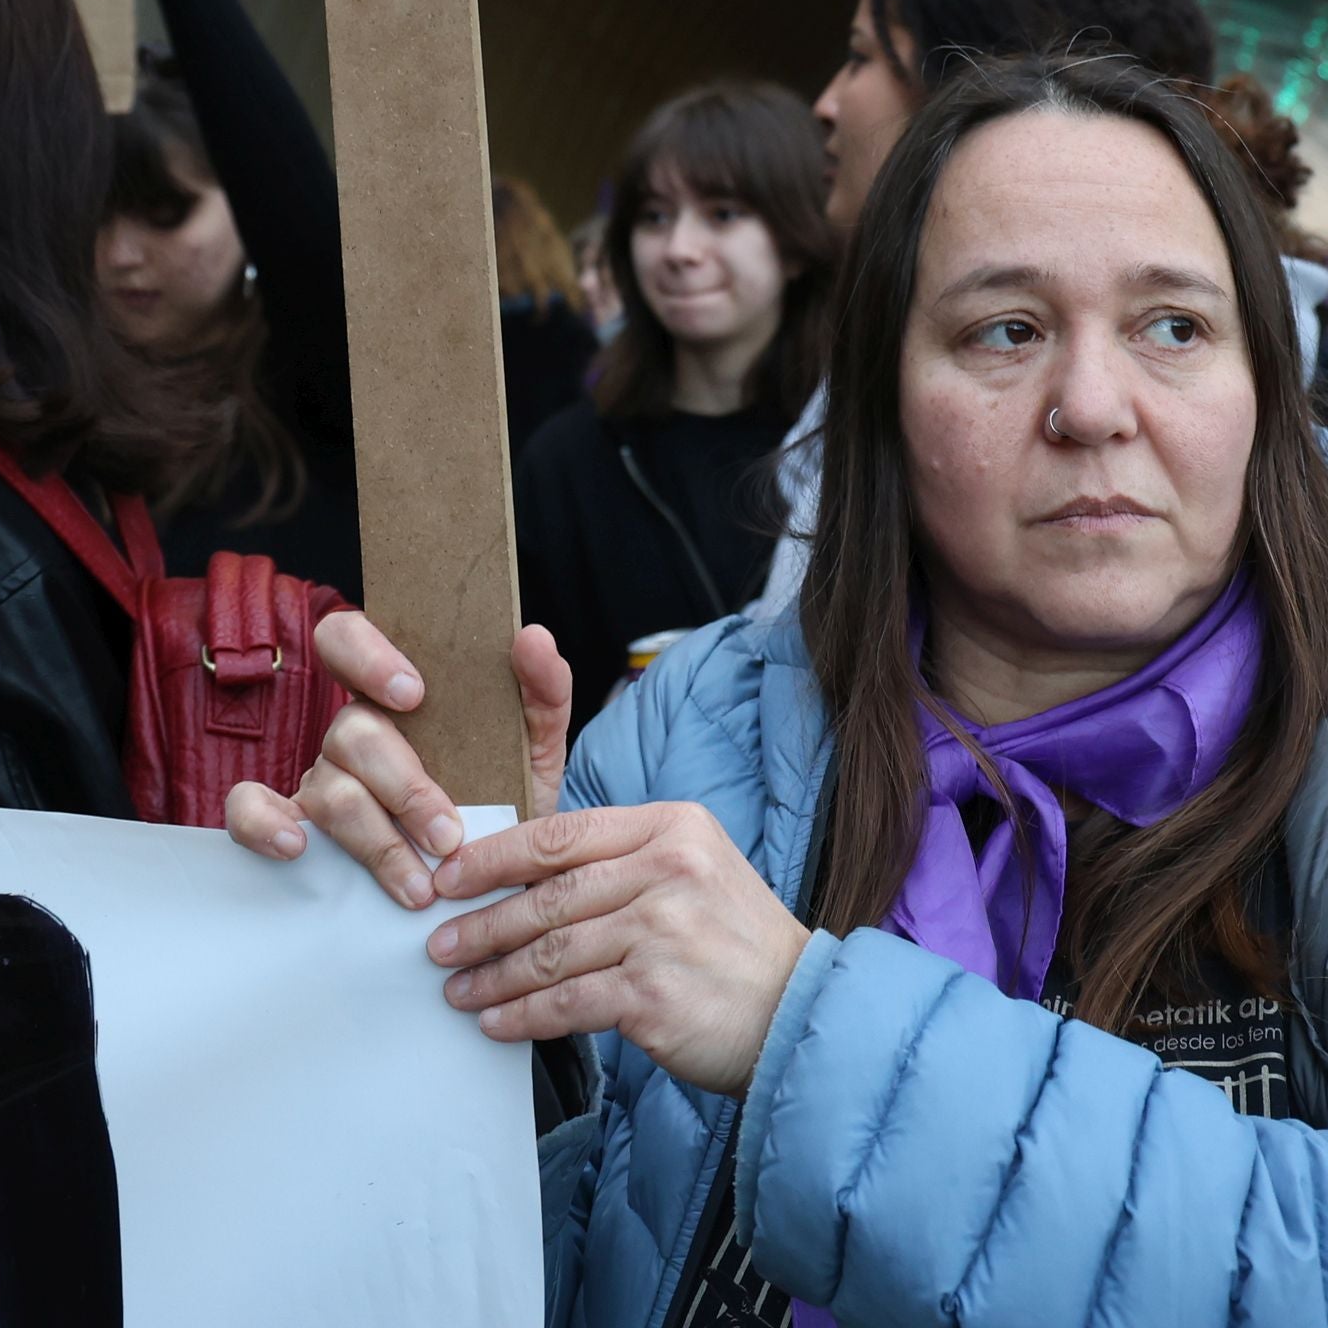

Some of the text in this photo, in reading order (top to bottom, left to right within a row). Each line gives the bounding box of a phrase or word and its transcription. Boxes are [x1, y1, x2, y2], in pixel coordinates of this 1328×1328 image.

[1154, 1025, 1284, 1053] desde los fem
